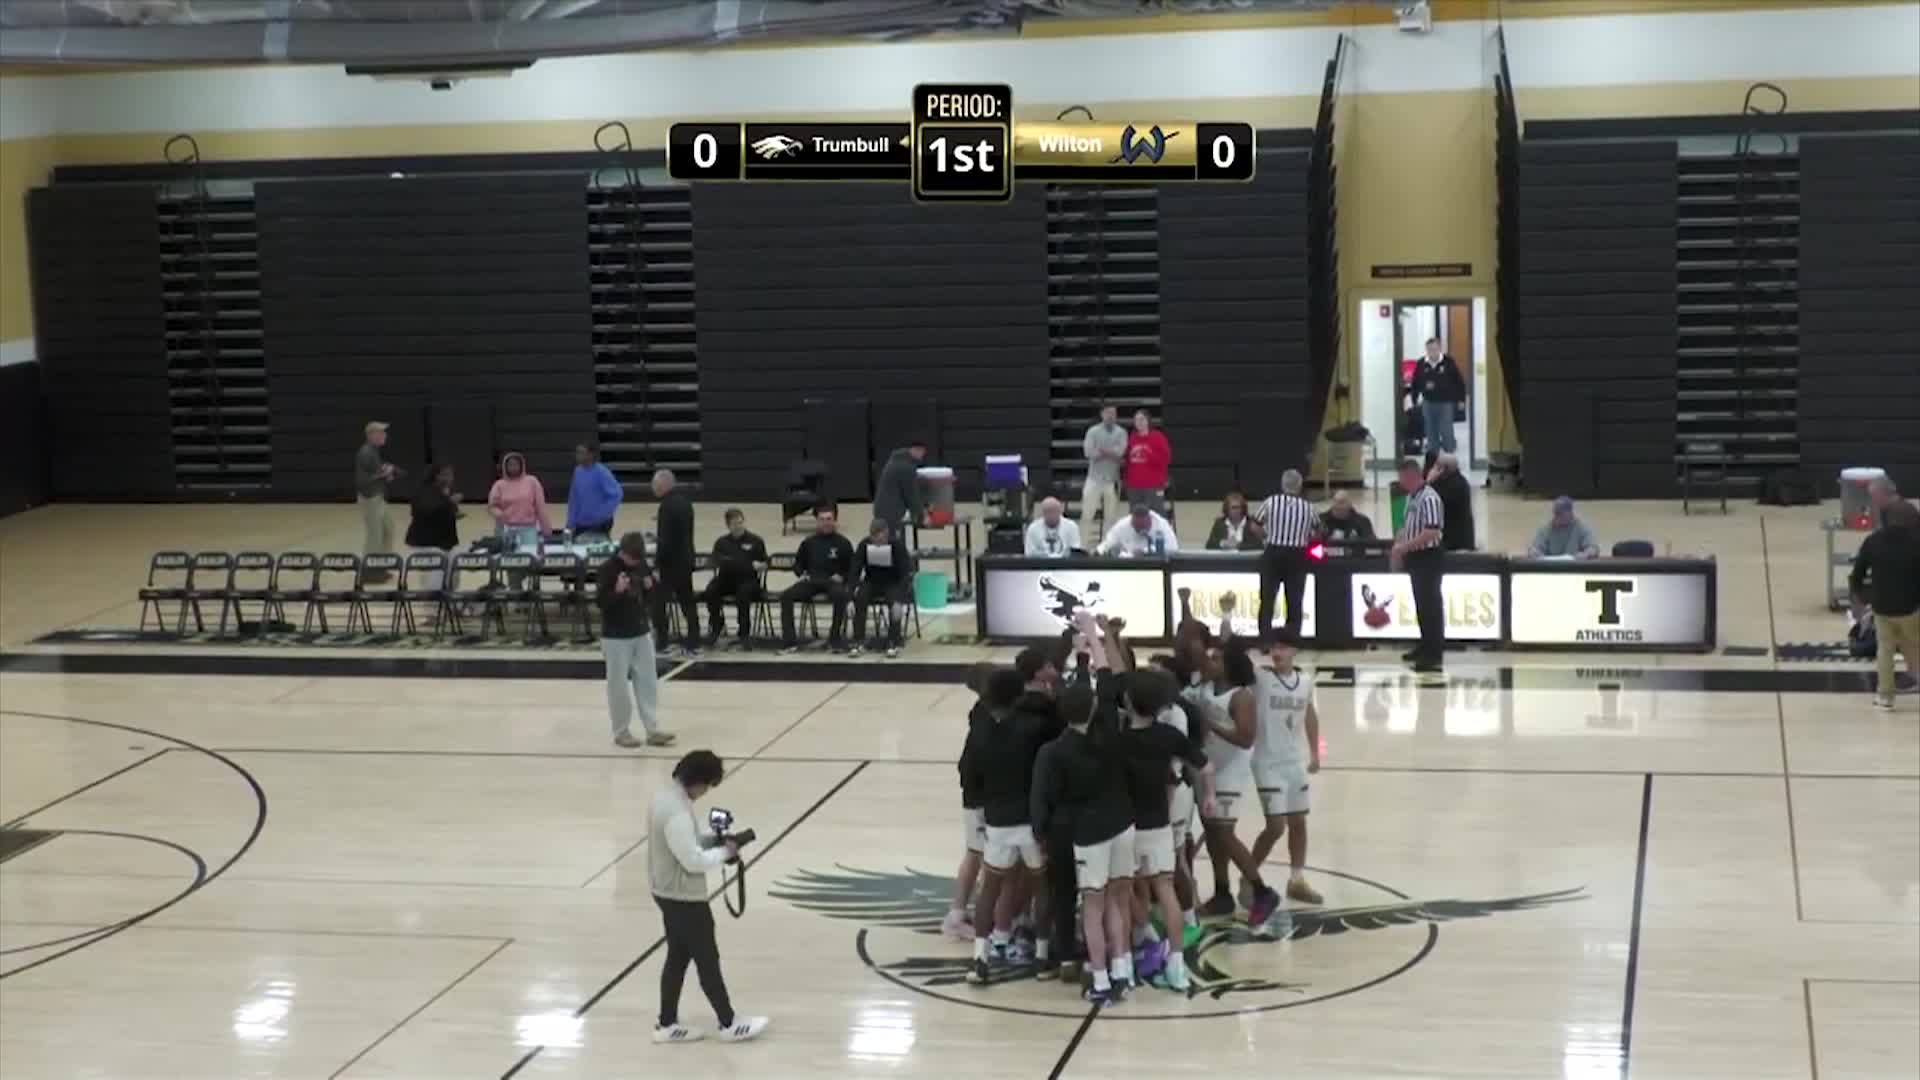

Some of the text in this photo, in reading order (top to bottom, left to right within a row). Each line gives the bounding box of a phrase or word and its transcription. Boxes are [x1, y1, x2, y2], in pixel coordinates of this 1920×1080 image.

[1397, 591, 1497, 629] ELES
[1585, 579, 1634, 625] T
[1575, 629, 1644, 642] ATHLETICS
